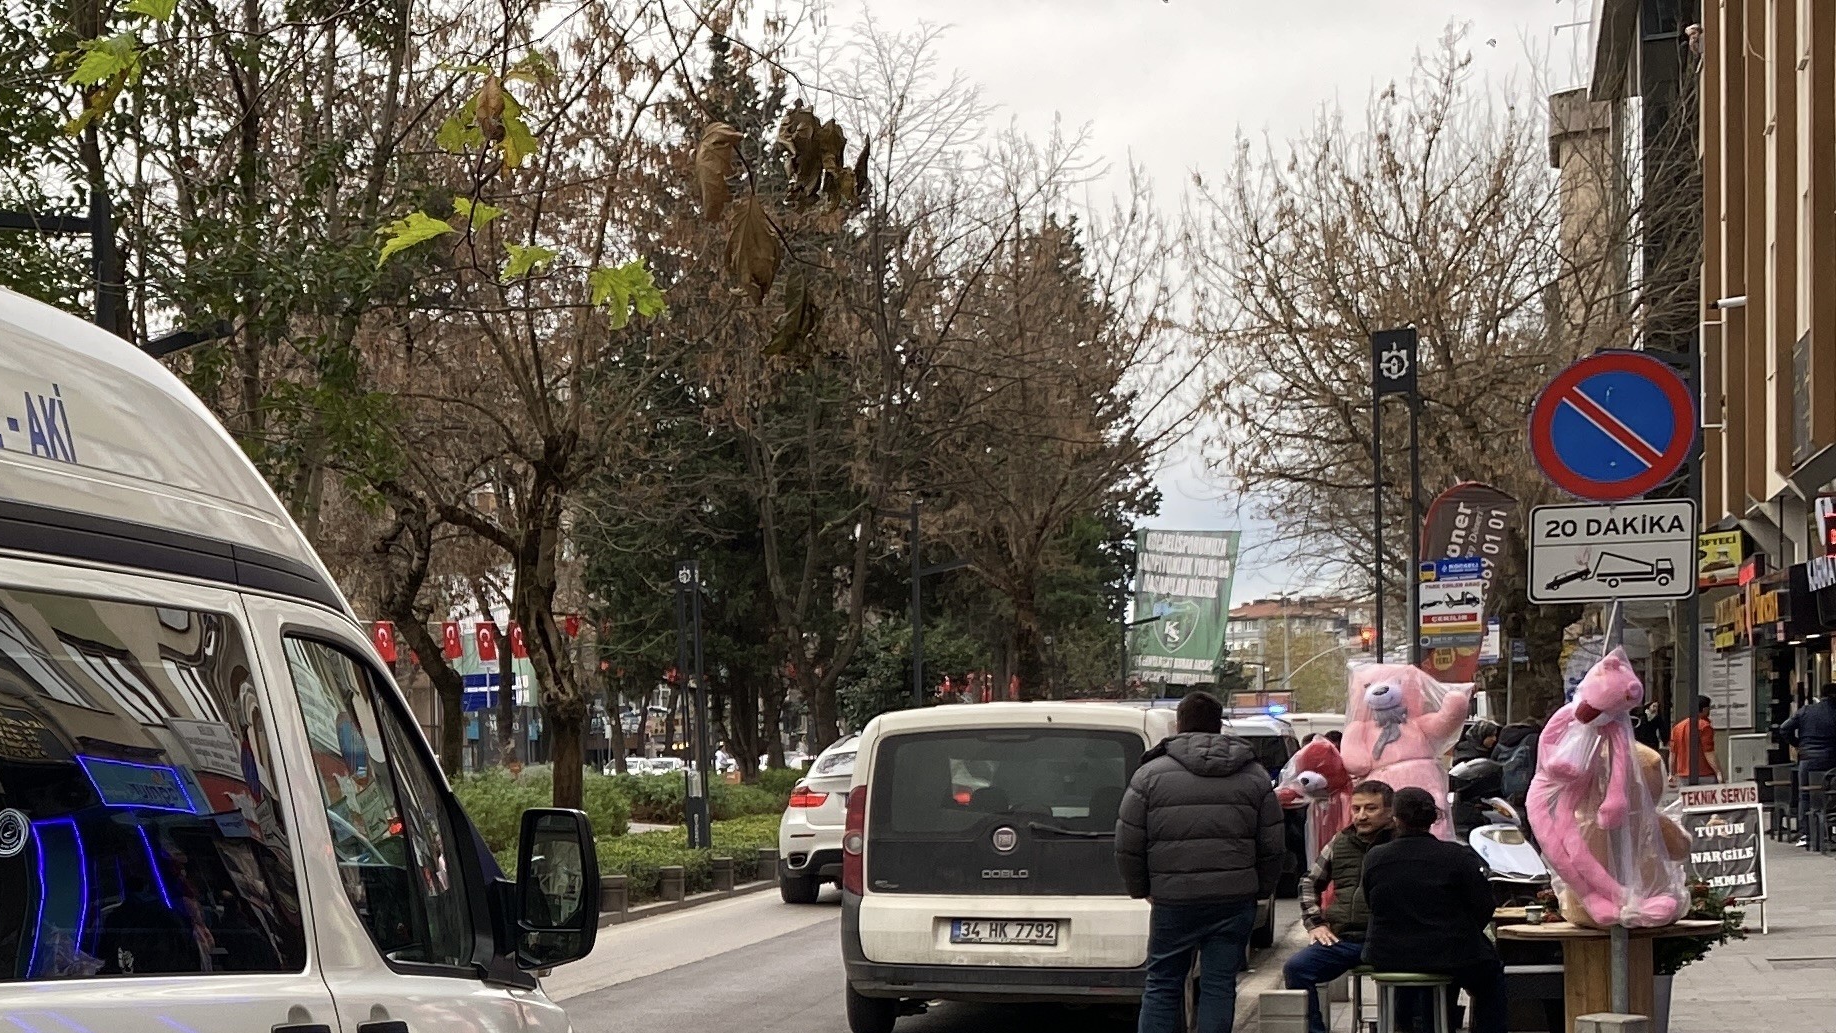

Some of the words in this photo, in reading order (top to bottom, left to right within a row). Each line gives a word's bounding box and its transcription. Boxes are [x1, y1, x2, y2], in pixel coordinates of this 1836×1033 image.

[24, 383, 78, 464] AKİ
[1545, 520, 1577, 538] 20
[1586, 514, 1685, 536] DAKİKA
[1691, 847, 1754, 864] NARGİLE
[981, 869, 1029, 879] DOBLO
[961, 922, 980, 938] 34
[989, 922, 1008, 938] HK
[1015, 923, 1054, 938] 7792
